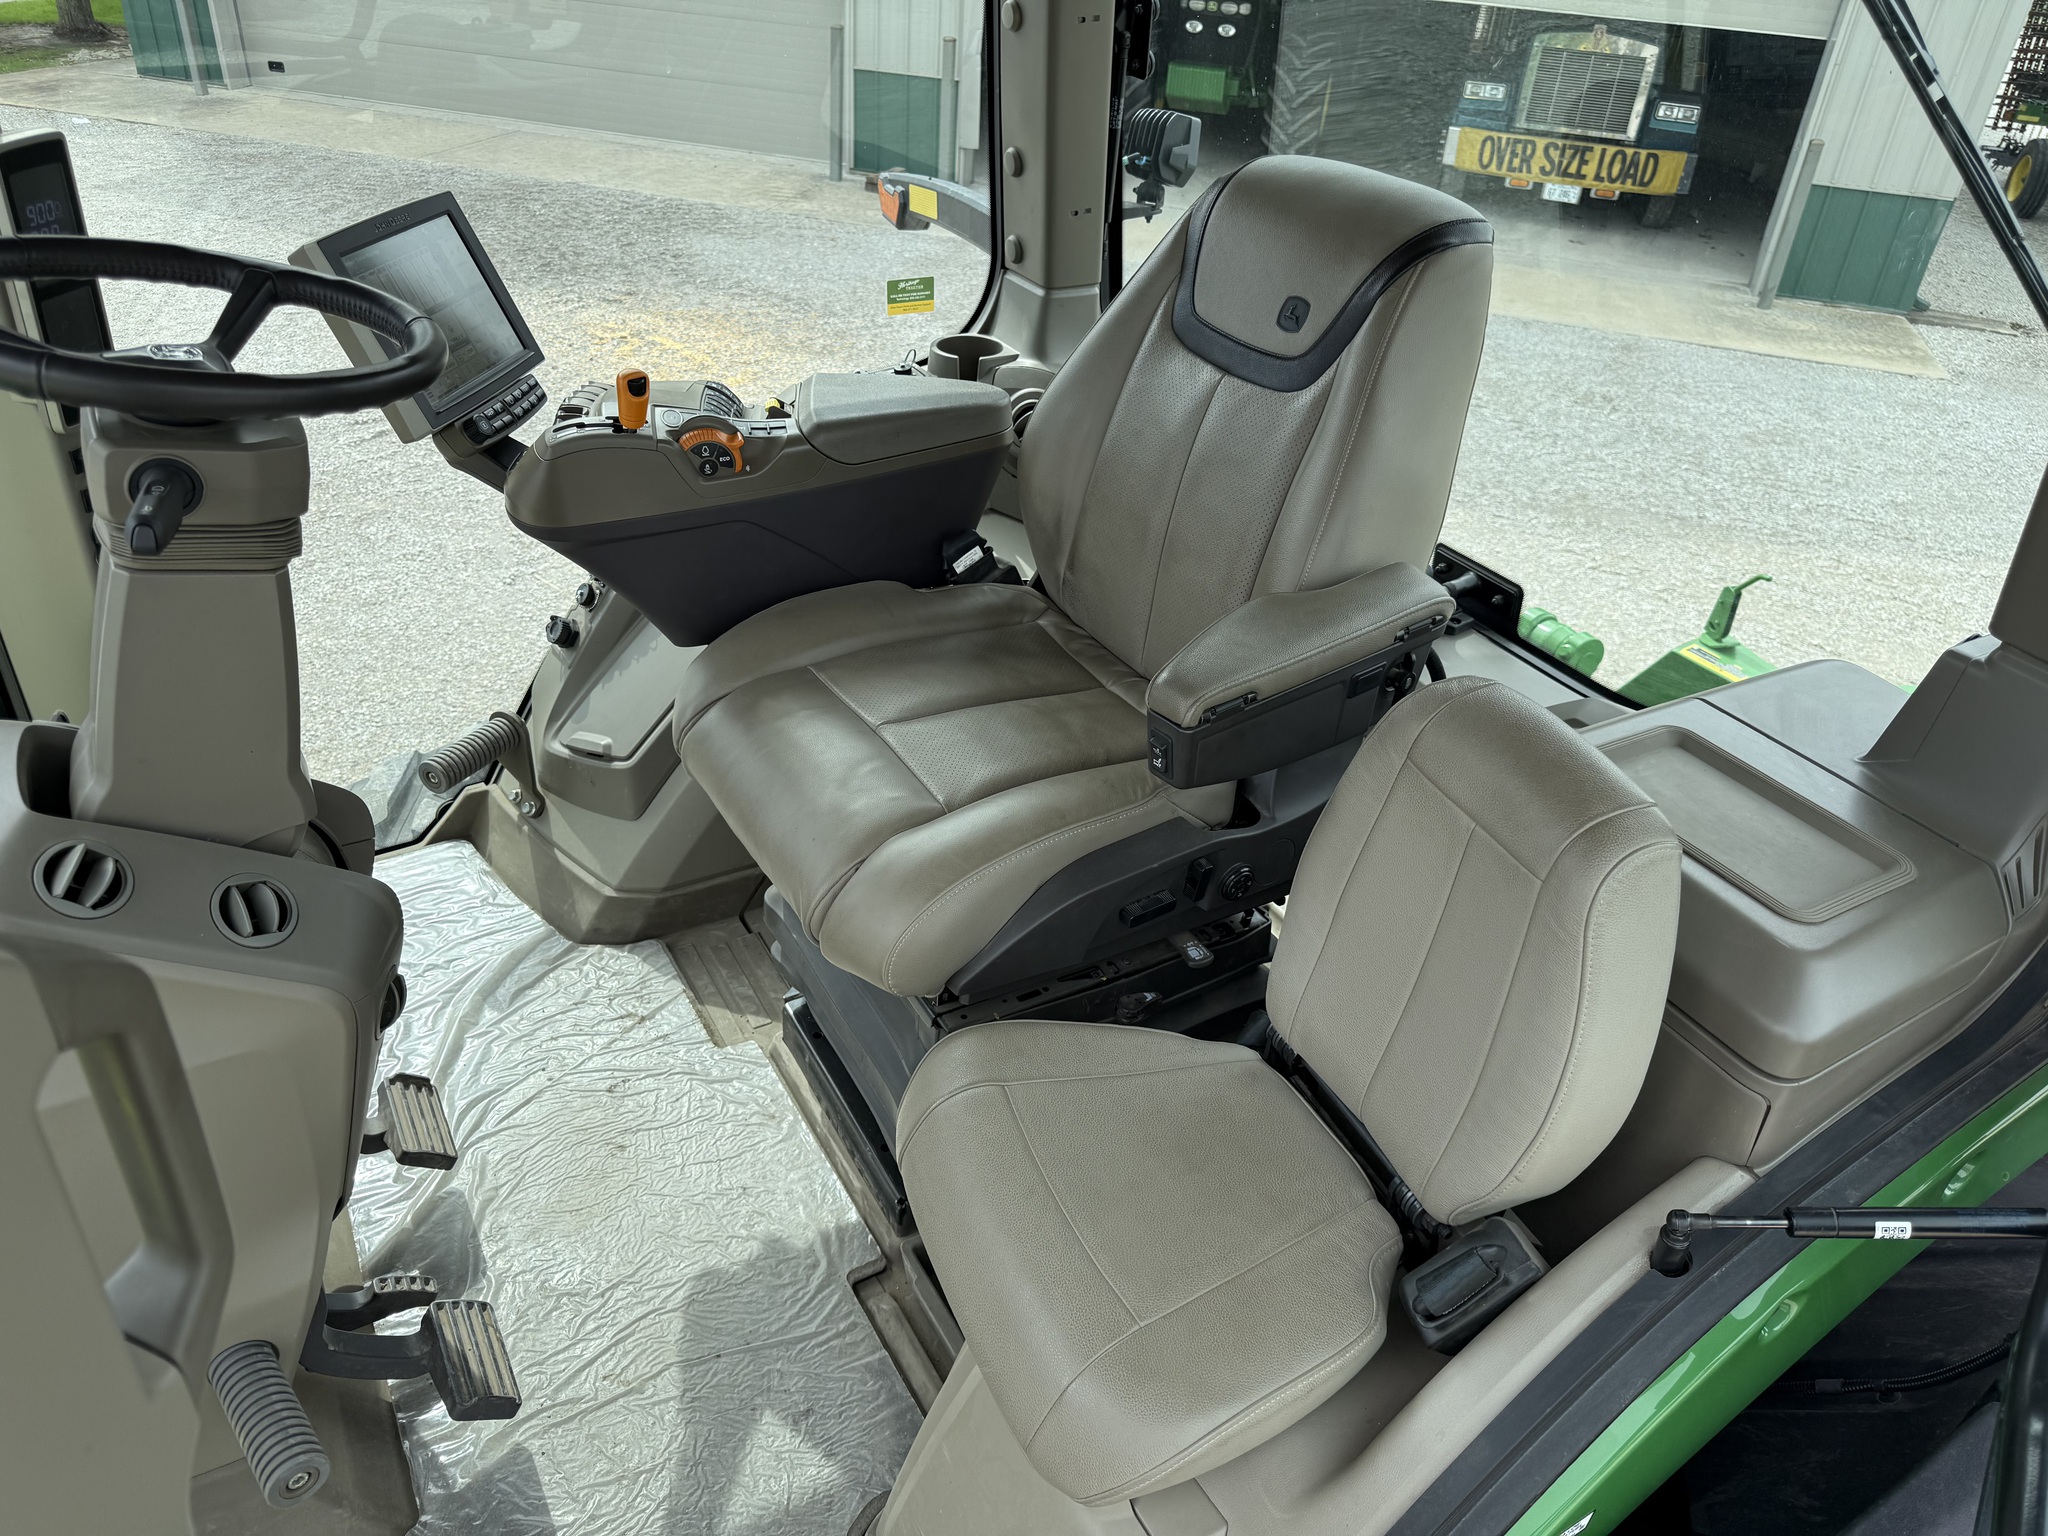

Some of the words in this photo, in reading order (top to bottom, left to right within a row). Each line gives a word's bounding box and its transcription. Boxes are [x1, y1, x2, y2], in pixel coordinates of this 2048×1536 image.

[1478, 135, 1537, 174] OVER
[1539, 141, 1594, 181] SIZE
[1594, 147, 1660, 189] LOAD
[26, 200, 55, 227] 900
